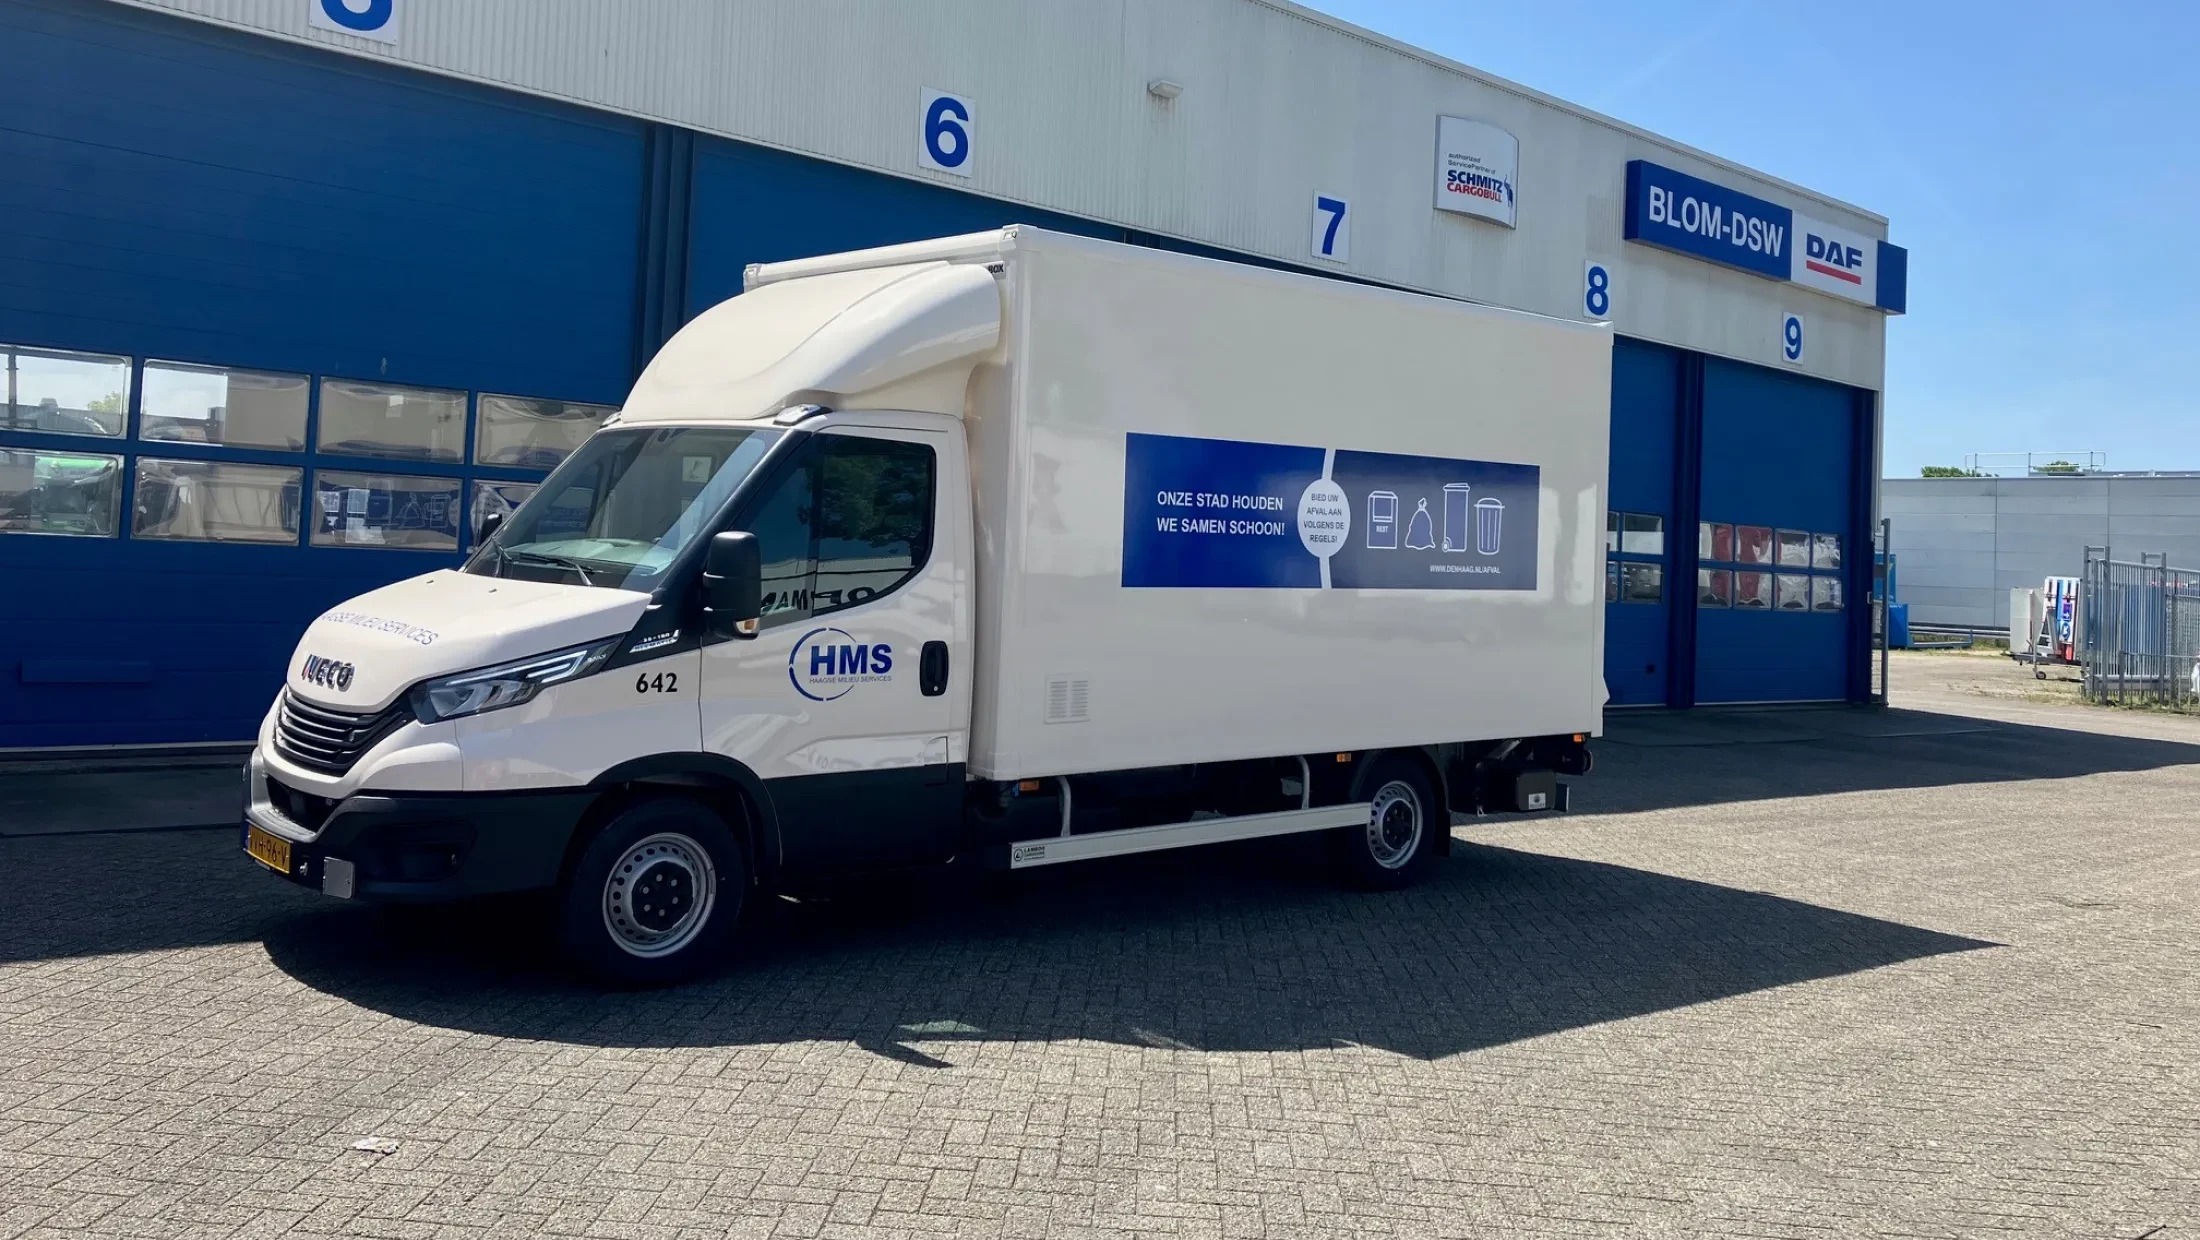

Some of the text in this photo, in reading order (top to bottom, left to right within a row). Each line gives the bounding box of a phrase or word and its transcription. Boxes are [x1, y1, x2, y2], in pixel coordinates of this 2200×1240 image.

[925, 97, 969, 169] 6
[1446, 182, 1502, 203] CARGOBULL
[1447, 169, 1503, 194] SCHMITZ
[1317, 196, 1346, 255] 7
[1649, 185, 1783, 258] BLOM-DSW
[1806, 232, 1863, 270] DAF
[1586, 265, 1609, 316] 8
[1784, 317, 1802, 361] 9
[1157, 491, 1283, 511] ONZE STAD HOUDEN
[1311, 493, 1339, 502] BIED UW
[1306, 507, 1342, 516] AFVAL AAN
[1157, 517, 1285, 536] WE SAMEN SCHOON!
[1303, 520, 1344, 530] VOLGENS DE
[1309, 534, 1338, 543] REGELS!
[810, 643, 892, 676] HMS
[301, 654, 355, 692] IVECO
[635, 672, 678, 693] 642
[809, 676, 836, 684] HAAGSE
[860, 675, 892, 683] SERVICES
